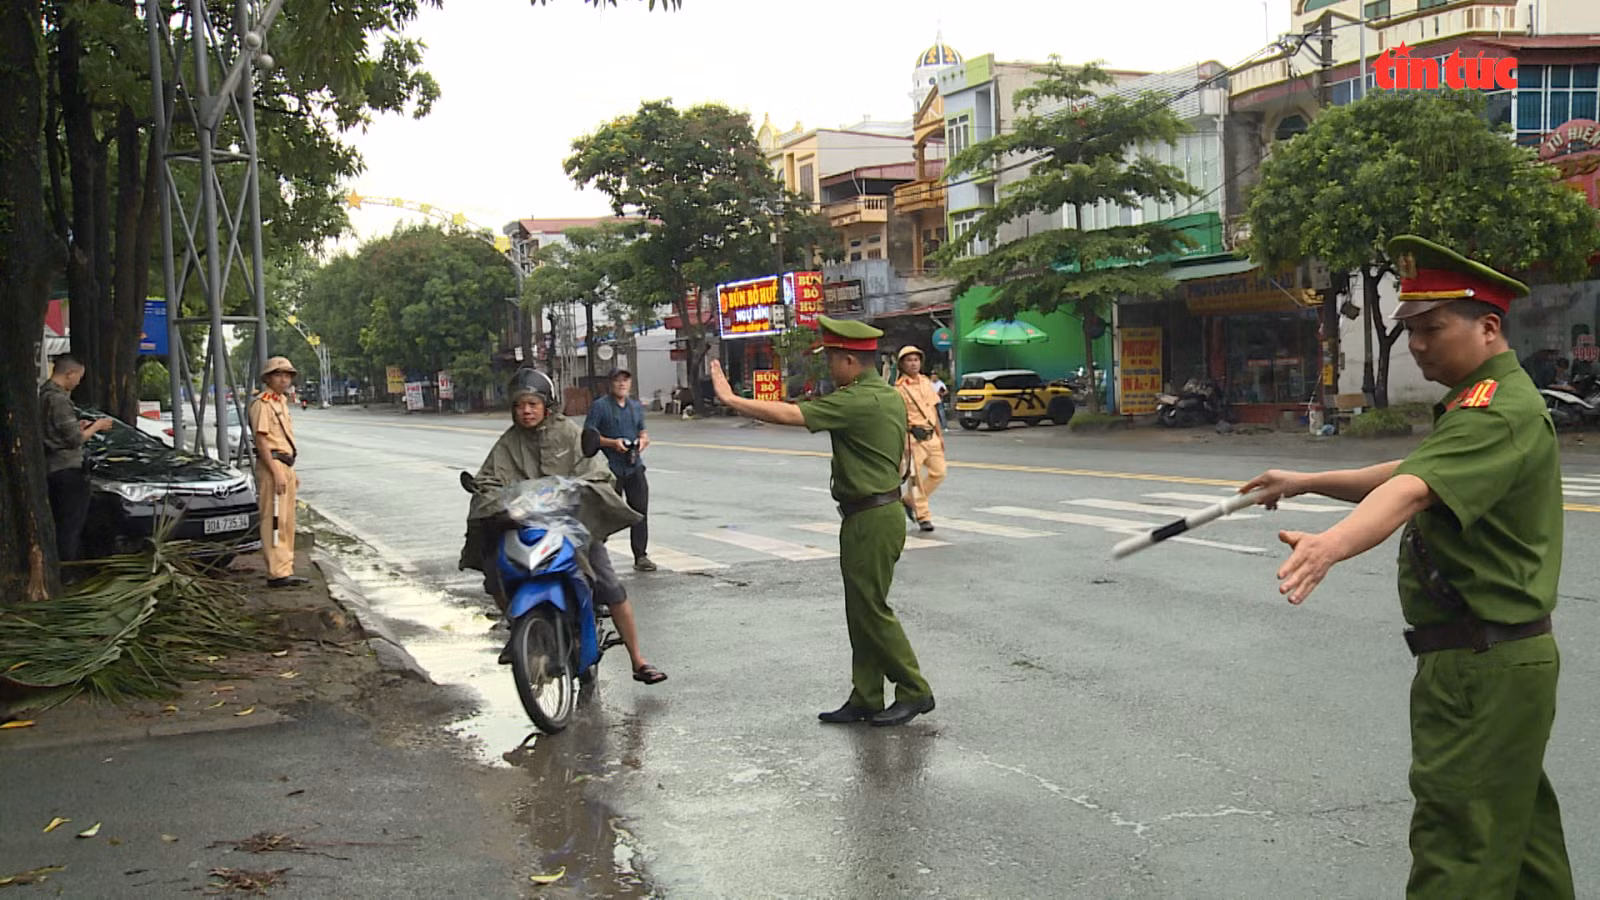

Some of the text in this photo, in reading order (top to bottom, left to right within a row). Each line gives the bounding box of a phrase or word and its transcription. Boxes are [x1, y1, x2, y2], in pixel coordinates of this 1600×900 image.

[798, 273, 822, 286] BÚN
[728, 286, 746, 308] BÚN
[747, 283, 759, 304] BÒ
[803, 286, 819, 298] BÒ
[756, 371, 779, 382] BÚN
[760, 379, 776, 391] BÒ
